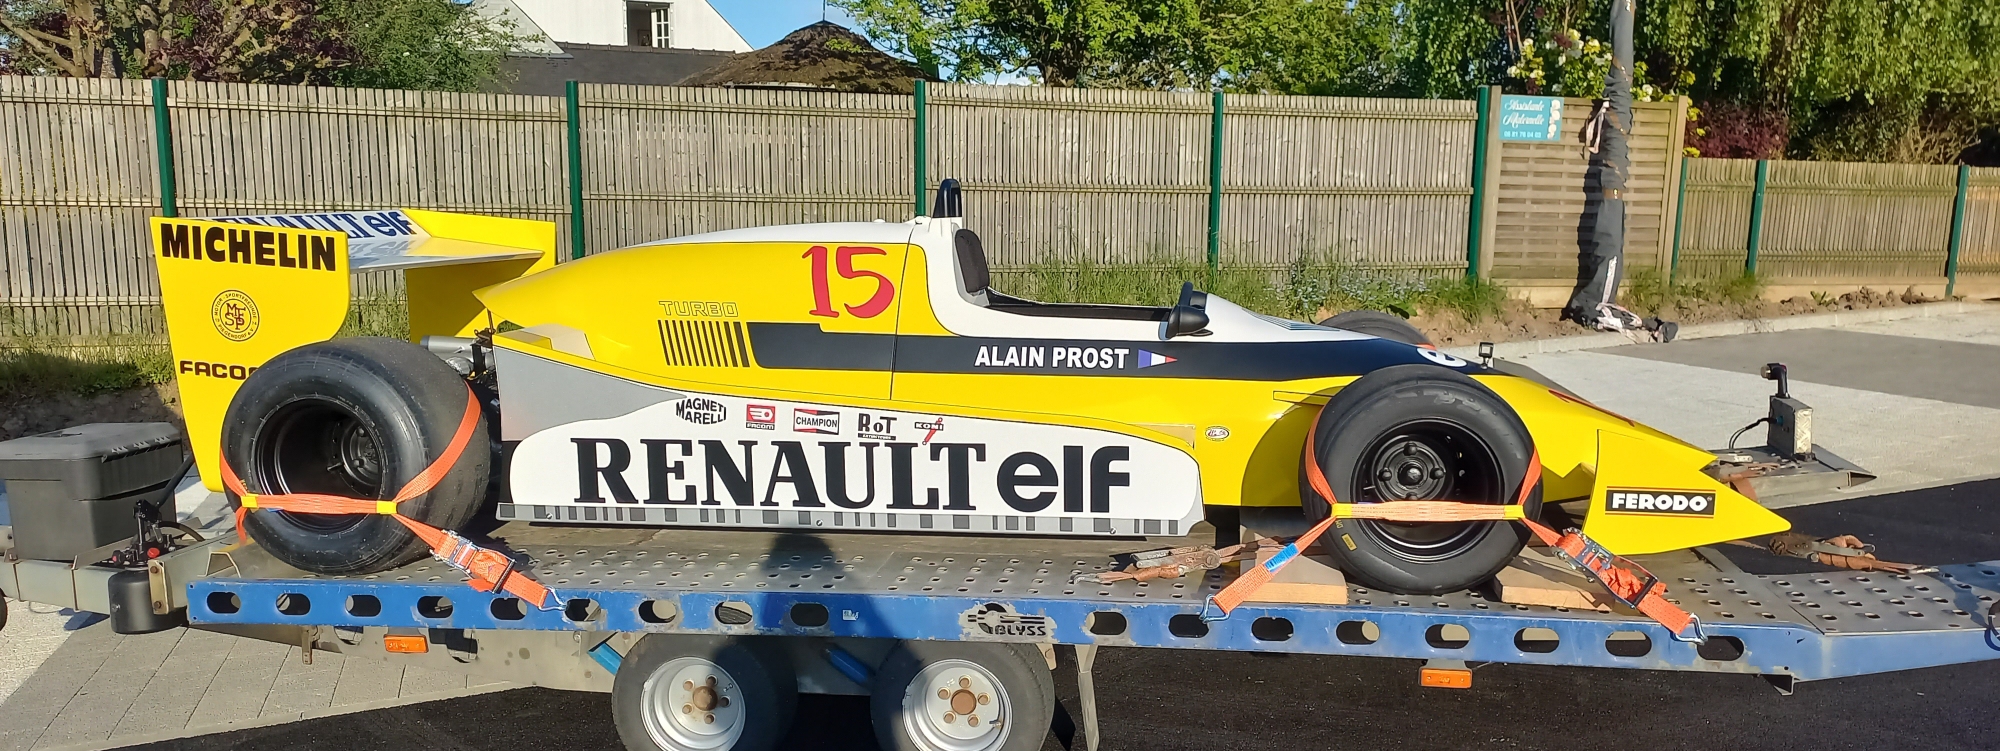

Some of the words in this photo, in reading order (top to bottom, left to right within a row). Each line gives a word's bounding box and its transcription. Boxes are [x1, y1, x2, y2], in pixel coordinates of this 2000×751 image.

[363, 211, 417, 237] elf
[160, 223, 336, 272] MICHELIN
[801, 245, 895, 319] 15
[658, 300, 739, 318] TURBO
[974, 345, 1045, 368] ALAIN
[1052, 346, 1130, 369] PROST
[179, 360, 259, 380] FACO
[676, 398, 727, 413] MAGNETI
[676, 410, 727, 425] MARELLI
[795, 416, 838, 428] CHAMPION
[570, 437, 986, 511] RENAULT
[996, 445, 1130, 513] elf
[1611, 492, 1708, 512] FERODO
